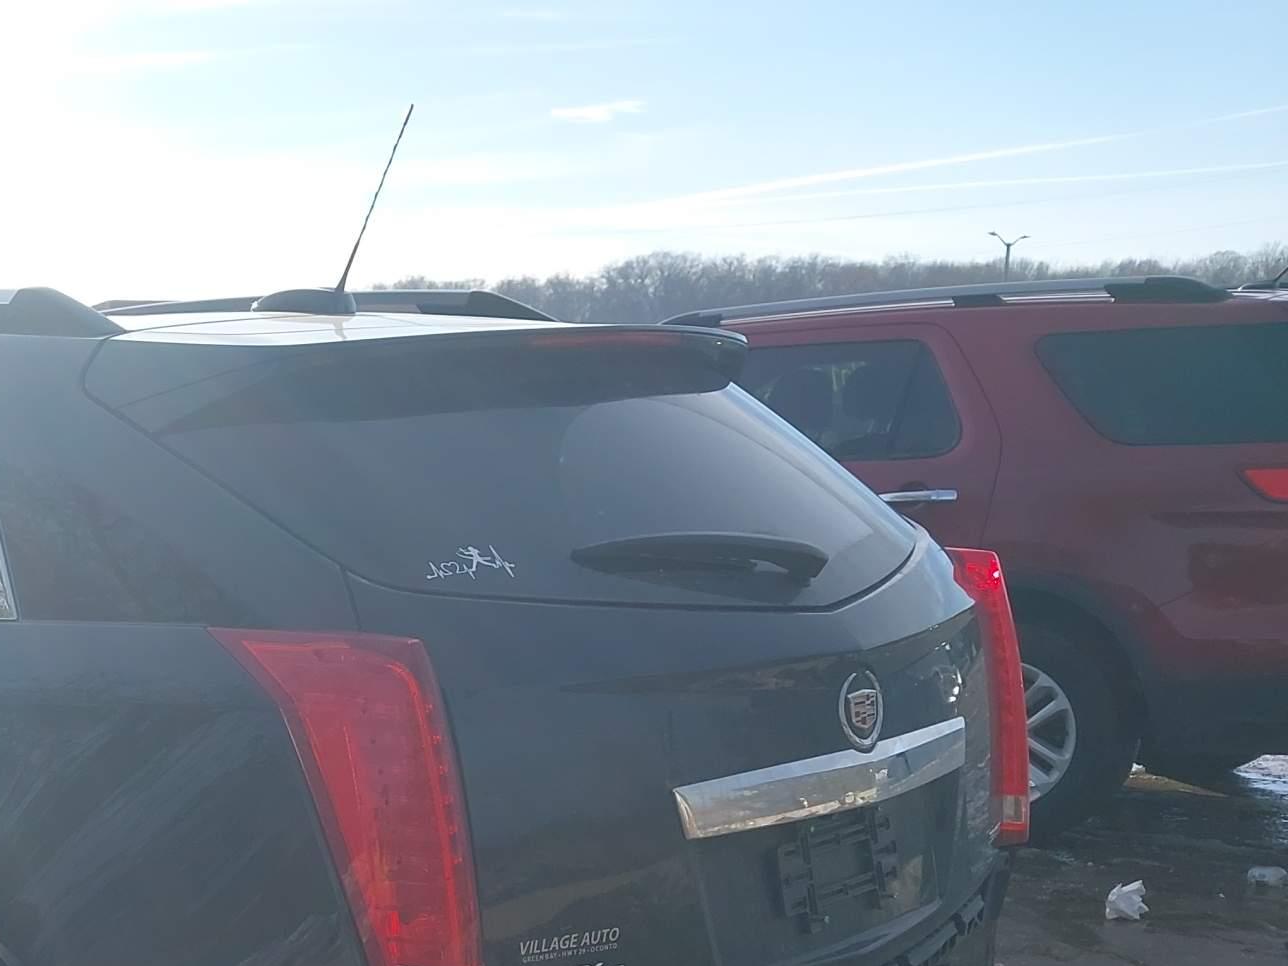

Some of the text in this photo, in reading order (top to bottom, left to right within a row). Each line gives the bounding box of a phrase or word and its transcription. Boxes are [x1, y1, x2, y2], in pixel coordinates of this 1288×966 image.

[519, 927, 621, 956] VILLAGE AUTO
[522, 954, 544, 964] GREEN
